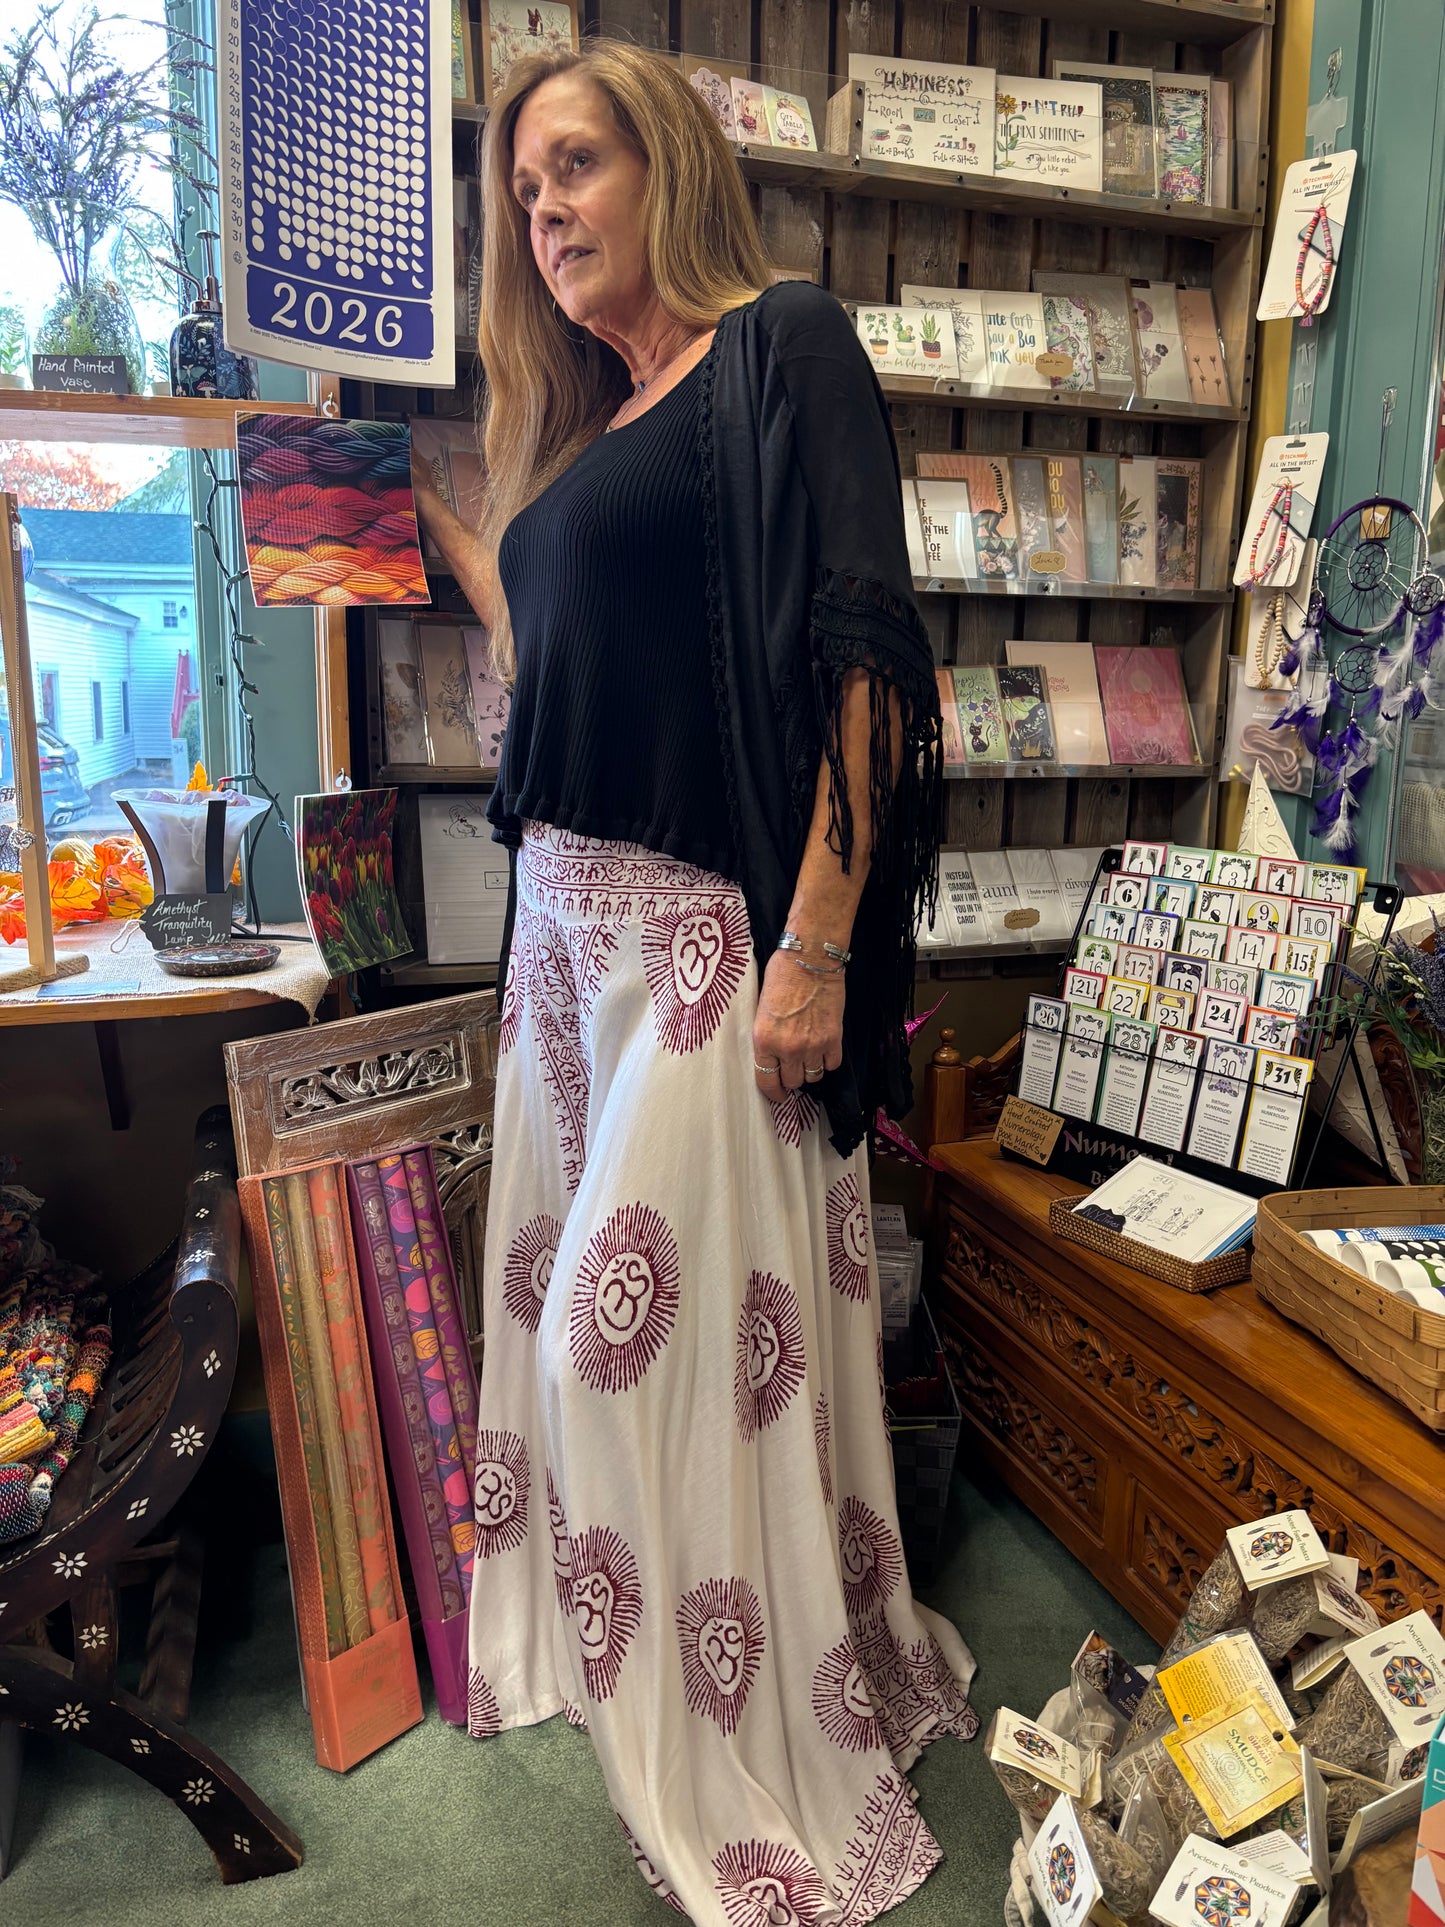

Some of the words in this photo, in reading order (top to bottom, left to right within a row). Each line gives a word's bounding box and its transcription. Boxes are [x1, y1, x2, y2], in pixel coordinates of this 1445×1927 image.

[230, 16, 239, 30] 19
[228, 32, 240, 48] 20
[229, 51, 239, 65] 21
[229, 67, 240, 85] 22
[229, 85, 240, 103] 23
[230, 104, 240, 119] 24
[230, 121, 241, 138] 25
[230, 140, 241, 154] 26
[230, 157, 241, 172] 27
[231, 175, 242, 190] 28
[231, 192, 242, 209] 29
[232, 210, 242, 227] 30
[232, 230, 242, 244] 31
[269, 280, 405, 350] 2026
[38, 356, 68, 373] Hand
[73, 357, 115, 374] Painted
[933, 525, 949, 534] THE
[1138, 861, 1144, 873] 1
[1183, 864, 1192, 878] 2
[945, 871, 970, 880] INSTEAD
[1229, 871, 1238, 886] 3
[1275, 874, 1285, 891] 4
[982, 885, 1018, 899] aunt
[1122, 886, 1132, 902] 6
[1324, 887, 1333, 902] 5
[152, 899, 208, 920] Amethyst
[1171, 898, 1180, 910] 7
[1259, 904, 1270, 920] 9
[1209, 908, 1221, 922] 8
[152, 916, 212, 938] Tranquility
[1104, 926, 1118, 940] 11
[1304, 918, 1327, 937] 10
[164, 933, 193, 945] Lamp
[1242, 943, 1258, 960] 14
[1089, 959, 1102, 974] 16
[1131, 960, 1146, 976] 17
[1292, 954, 1308, 971] 15
[1076, 980, 1093, 994] 21
[1175, 978, 1192, 991] 18
[1221, 977, 1238, 993] 19
[1115, 994, 1133, 1012] 22
[1275, 987, 1296, 1006] 20
[1040, 1010, 1054, 1026] 26
[1160, 1010, 1178, 1026] 23
[1208, 1004, 1230, 1024] 24
[1080, 1027, 1095, 1044] 27
[1120, 1030, 1141, 1050] 28
[1258, 1023, 1279, 1042] 25
[1166, 1058, 1184, 1075] 29
[1218, 1059, 1236, 1077] 30
[1274, 1066, 1290, 1084] 31
[1405, 1623, 1427, 1653] Ancient
[1226, 1739, 1247, 1770] MOUNTAIN
[1228, 1728, 1271, 1785] SMUDGE
[1187, 1848, 1219, 1869] Ancient
[1249, 1877, 1286, 1900] Products
